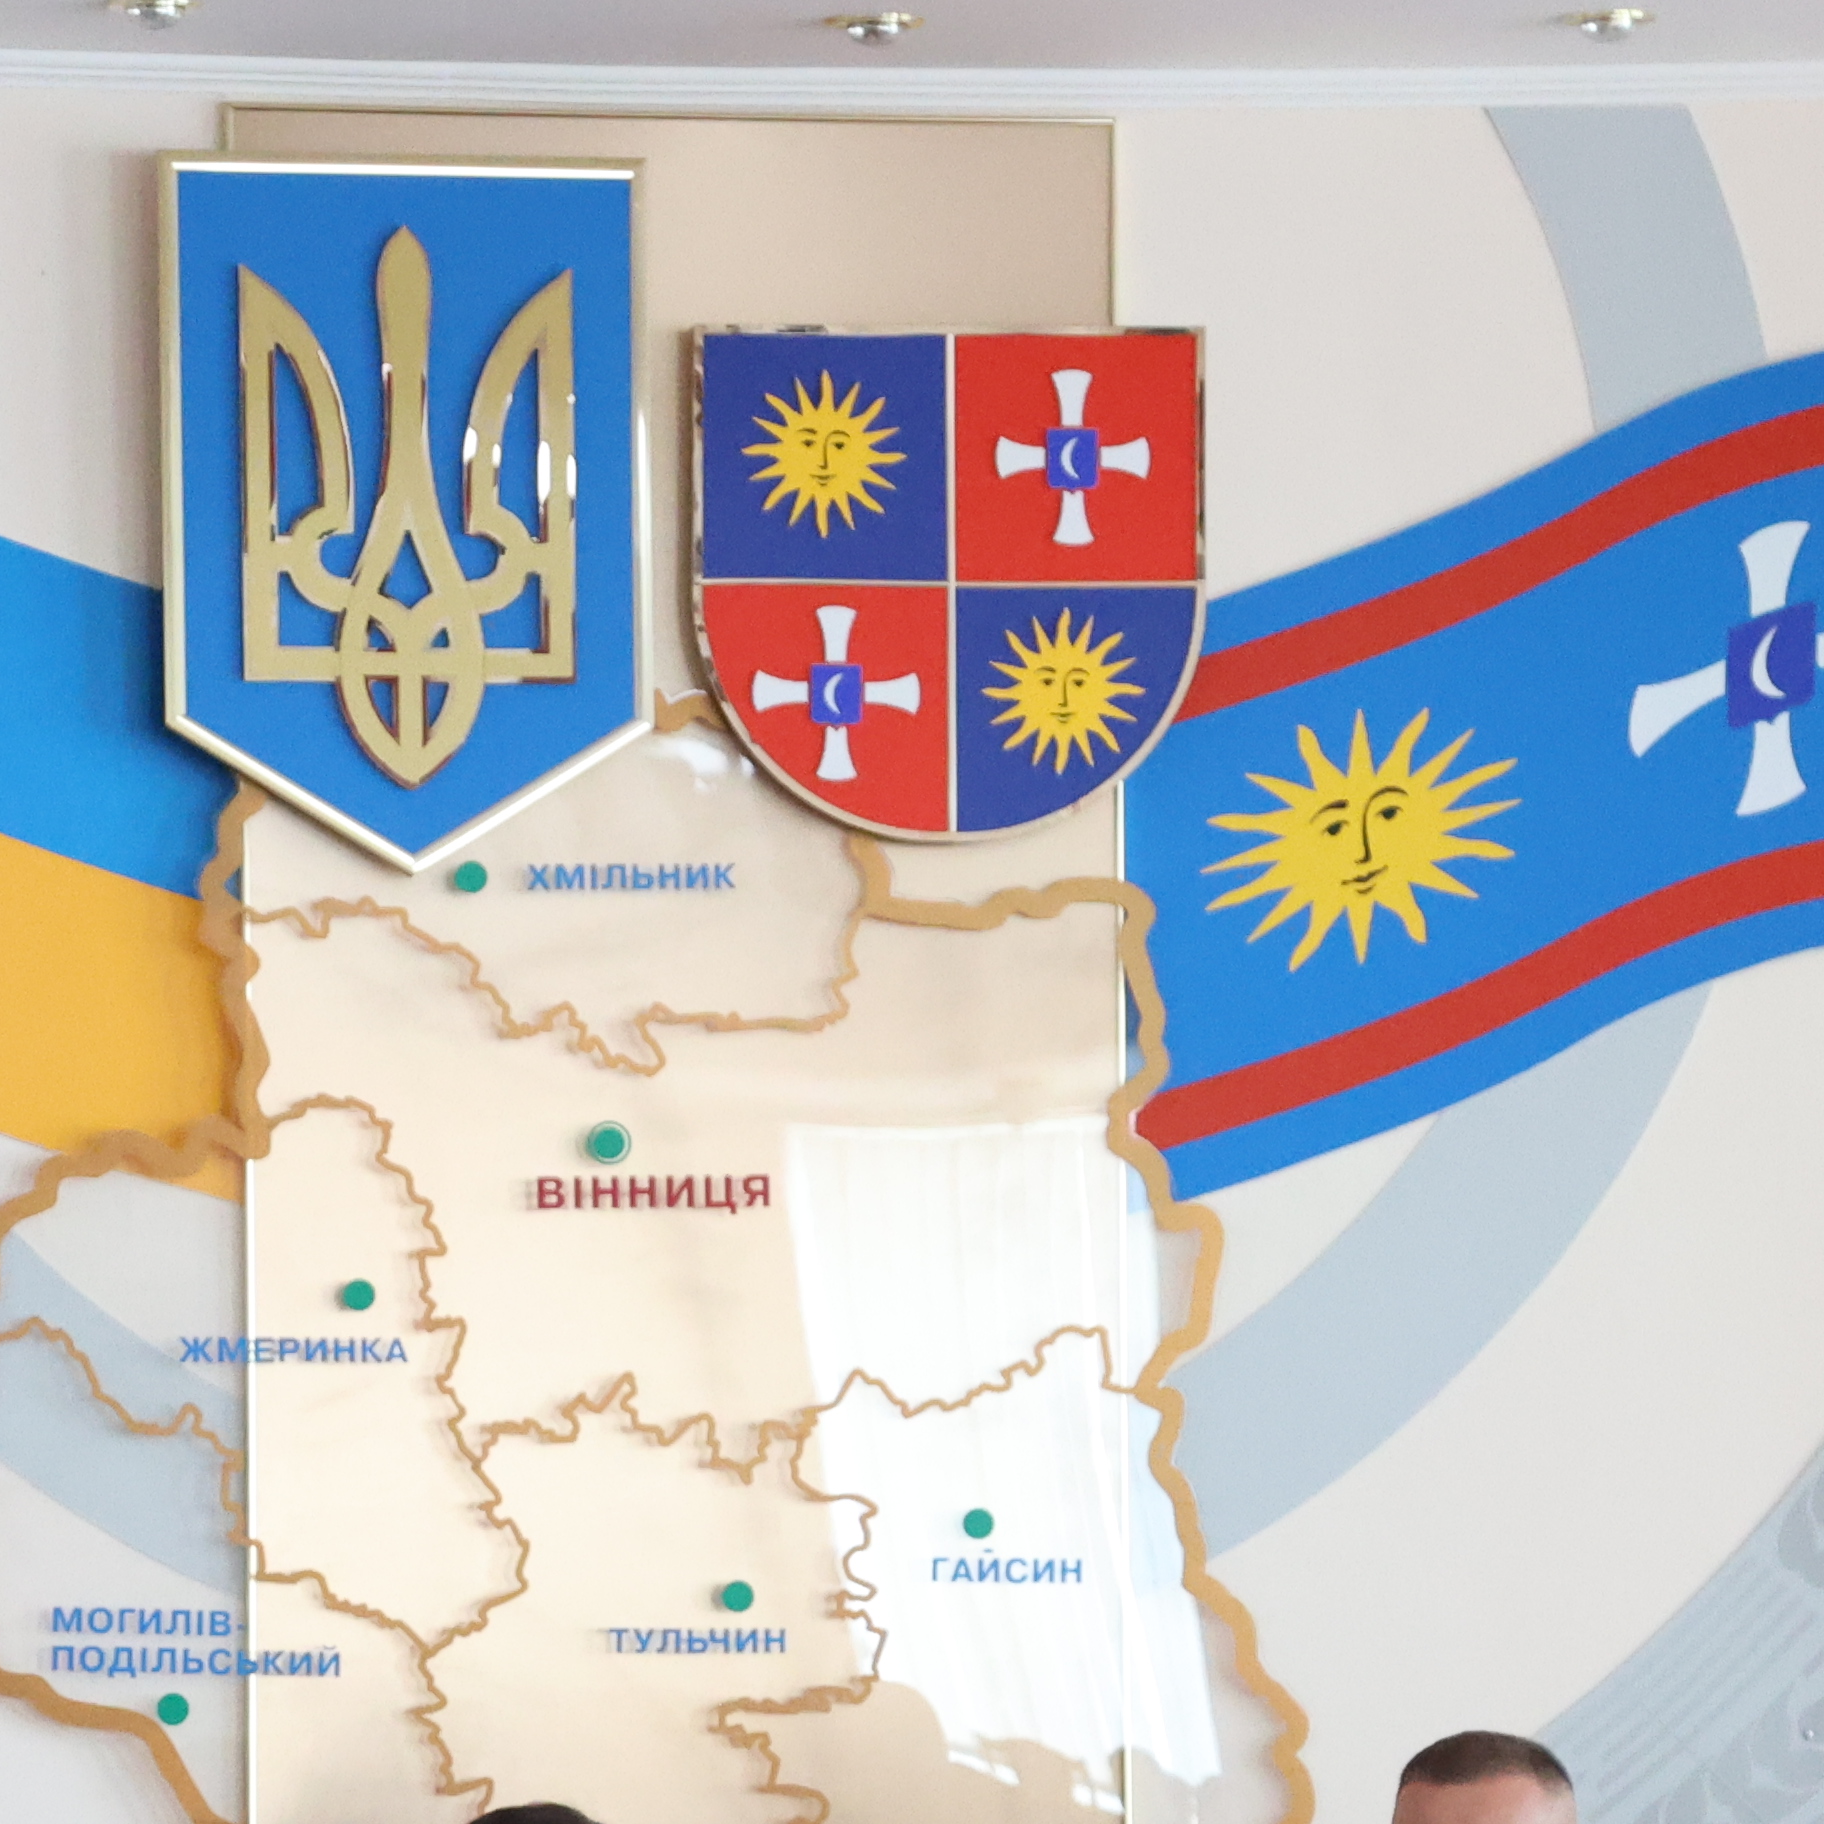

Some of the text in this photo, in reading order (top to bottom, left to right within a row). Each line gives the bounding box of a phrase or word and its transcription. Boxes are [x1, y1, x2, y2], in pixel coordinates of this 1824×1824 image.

[529, 864, 735, 891] ХМІЛЬНИК
[538, 1175, 770, 1214] ВІННИЦЯ
[179, 1335, 407, 1364] ЖМЕРИНКА
[932, 1551, 1083, 1584] ГАЙСИН
[52, 1606, 245, 1637] МОГИЛІВ-
[610, 1629, 786, 1655] ТУЛЬЧИН
[52, 1645, 341, 1678] ПОДІЛЬСЬКИЙ
